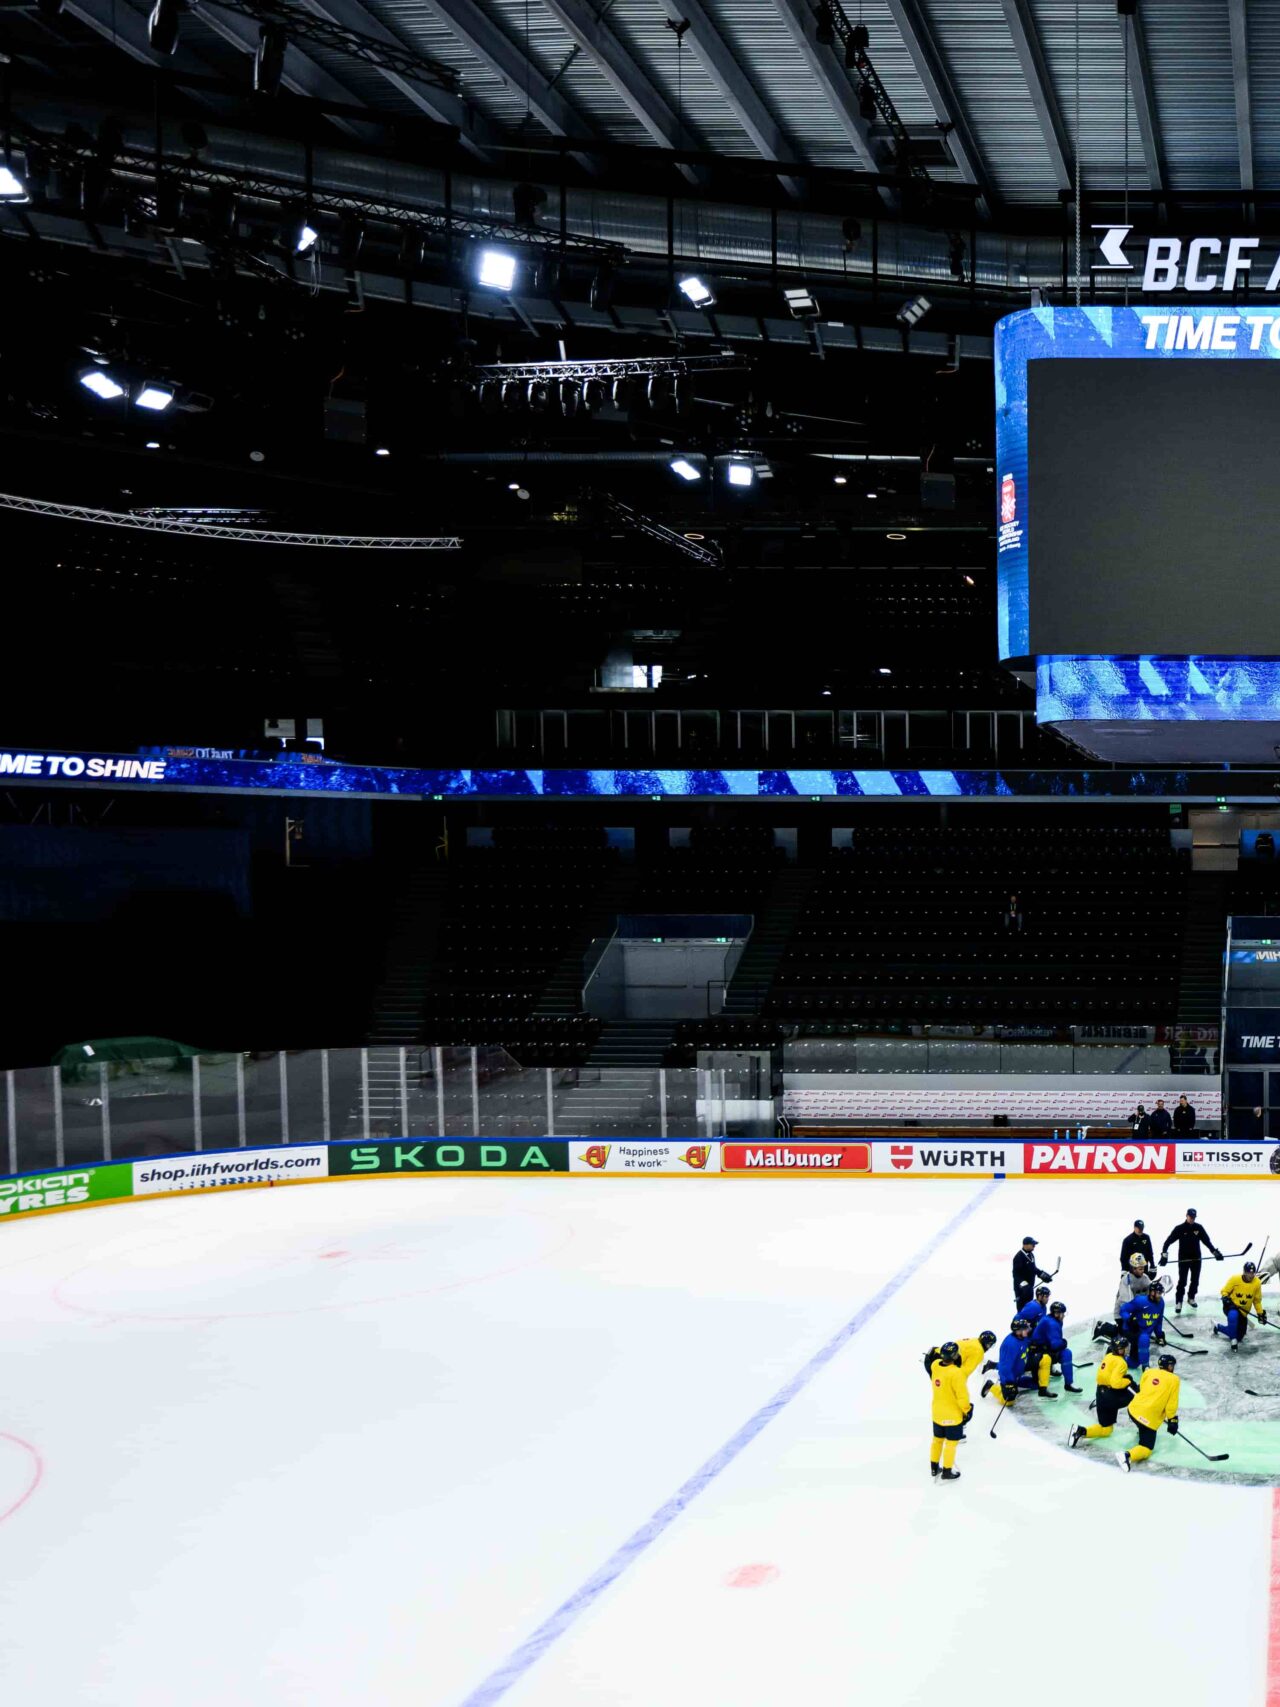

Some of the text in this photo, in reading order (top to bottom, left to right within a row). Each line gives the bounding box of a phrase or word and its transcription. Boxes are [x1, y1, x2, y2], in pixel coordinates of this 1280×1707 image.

[1141, 237, 1260, 292] BCF
[1141, 314, 1241, 351] TIME
[0, 753, 167, 780] ME TO SHINE
[1240, 1035, 1275, 1049] TIME
[618, 1146, 670, 1157] Happiness
[624, 1158, 636, 1168] at
[744, 1149, 843, 1168] Malbuner
[919, 1149, 1006, 1167] WÜRTH
[1030, 1145, 1169, 1173] PATRON
[1205, 1151, 1264, 1162] TISSOT
[139, 1154, 321, 1183] shop.iihfworlds.com
[0, 1186, 90, 1214] YRES
